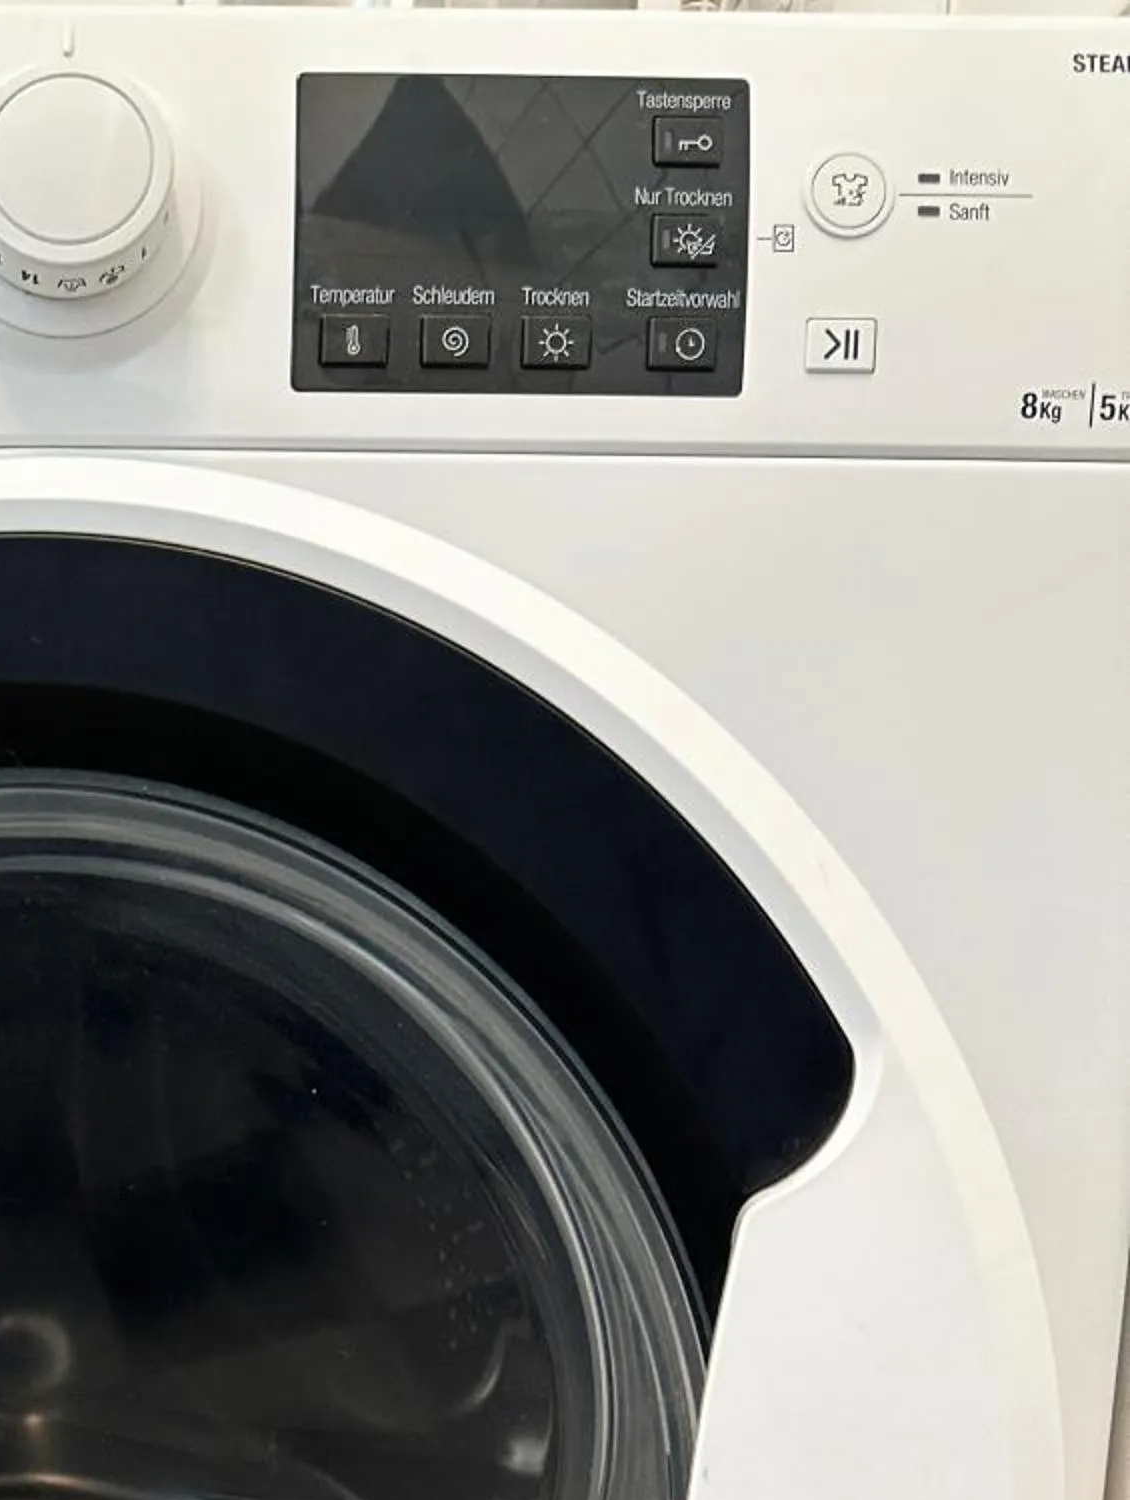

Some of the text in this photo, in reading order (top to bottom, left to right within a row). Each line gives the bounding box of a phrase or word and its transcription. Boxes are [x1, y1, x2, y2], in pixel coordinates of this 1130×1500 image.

[1073, 53, 1130, 73] STEA
[637, 91, 731, 111] Tastensperre
[949, 169, 1009, 187] Intensiv
[635, 189, 733, 207] Nur Trocknen
[949, 203, 990, 221] Sanft
[310, 285, 395, 306] Temperatur
[413, 285, 495, 306] Schleudern
[522, 286, 590, 307] Trocknen
[626, 288, 740, 310] Startzeitvorwahl
